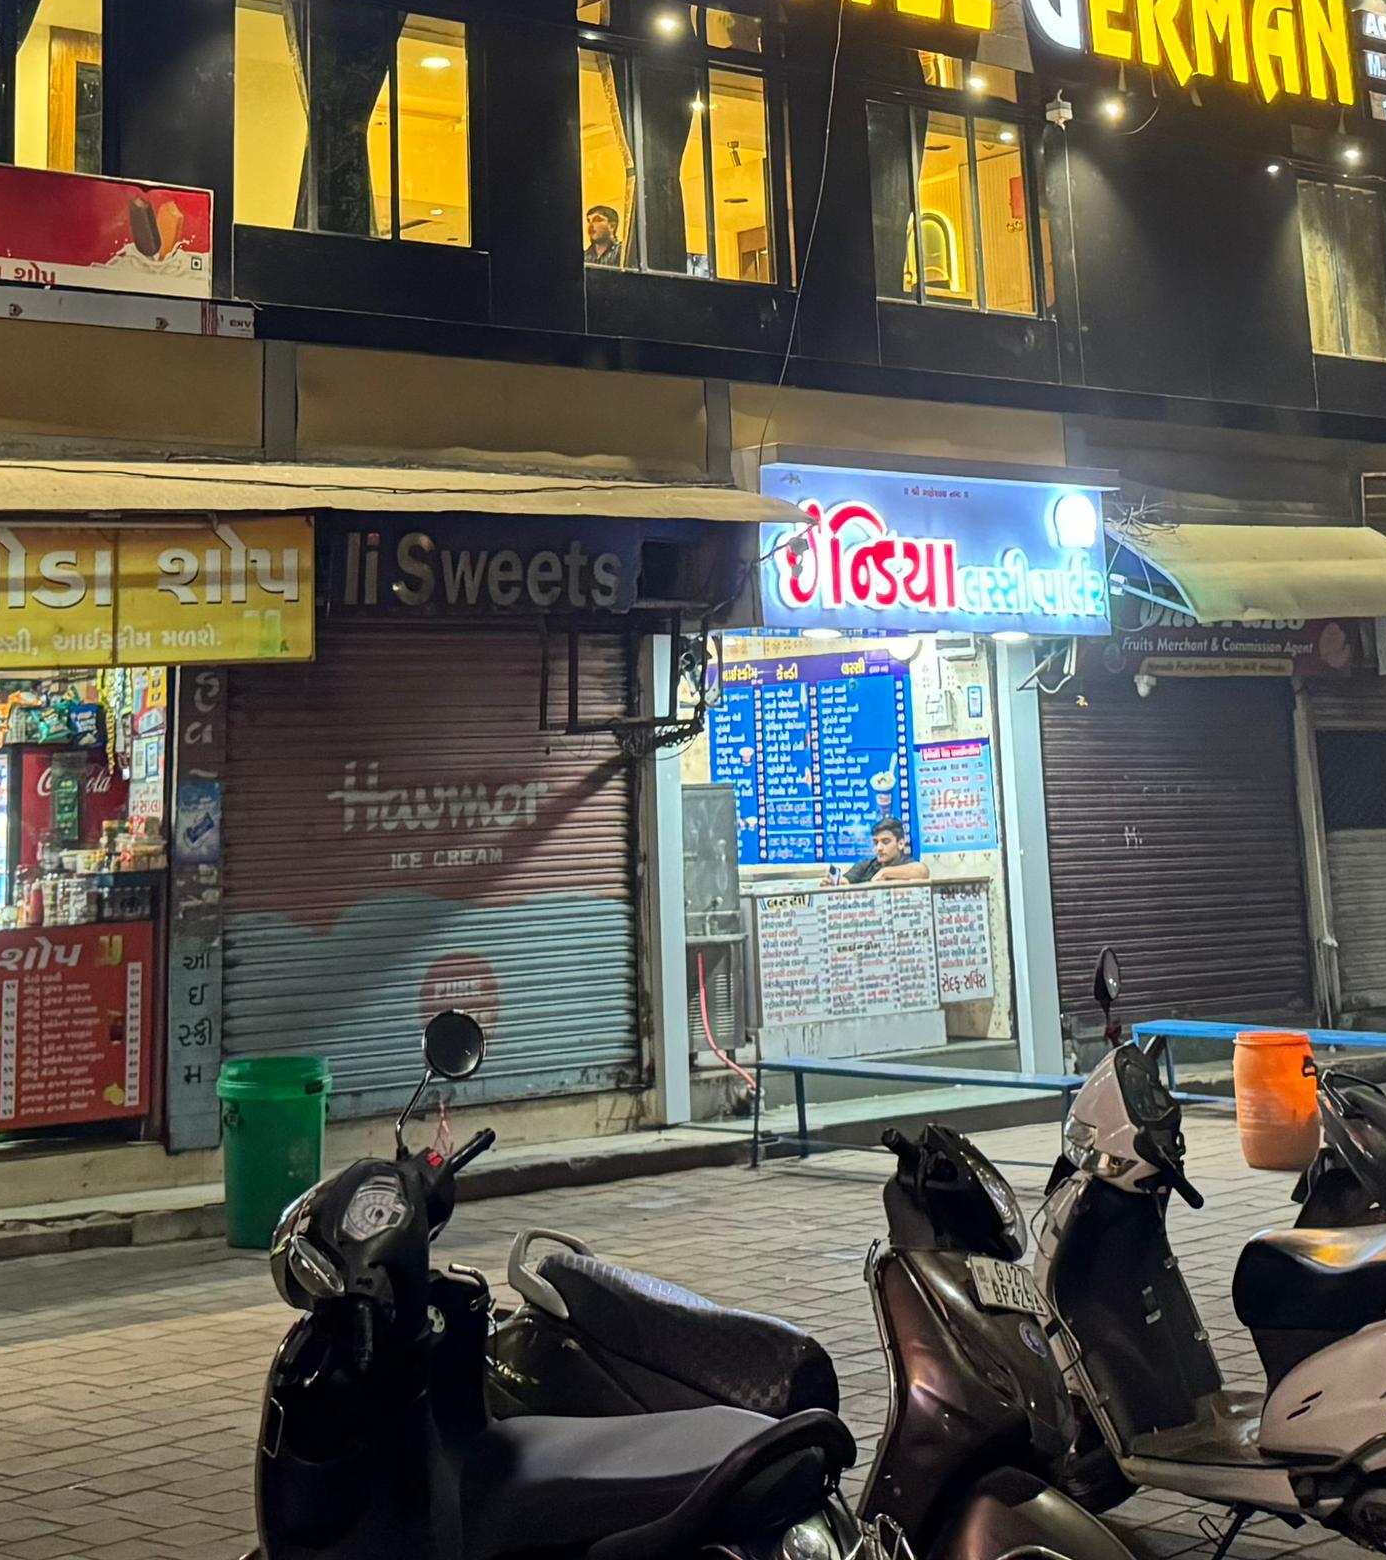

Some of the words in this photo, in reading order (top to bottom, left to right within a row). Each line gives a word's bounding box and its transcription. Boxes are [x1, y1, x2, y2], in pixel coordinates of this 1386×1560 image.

[1367, 52, 1386, 78] M.
[157, 524, 300, 605] શોપ
[392, 531, 623, 608] Sweets
[961, 548, 1031, 614] લસ્સી
[1031, 550, 1107, 617] પાર્લર
[1121, 636, 1154, 652] Fruits
[1157, 637, 1208, 652] Merchant
[1211, 638, 1219, 652] &
[1222, 637, 1282, 654] Commission
[1284, 641, 1314, 657] Agent
[390, 852, 423, 870] ICE
[433, 847, 503, 867] CREAM
